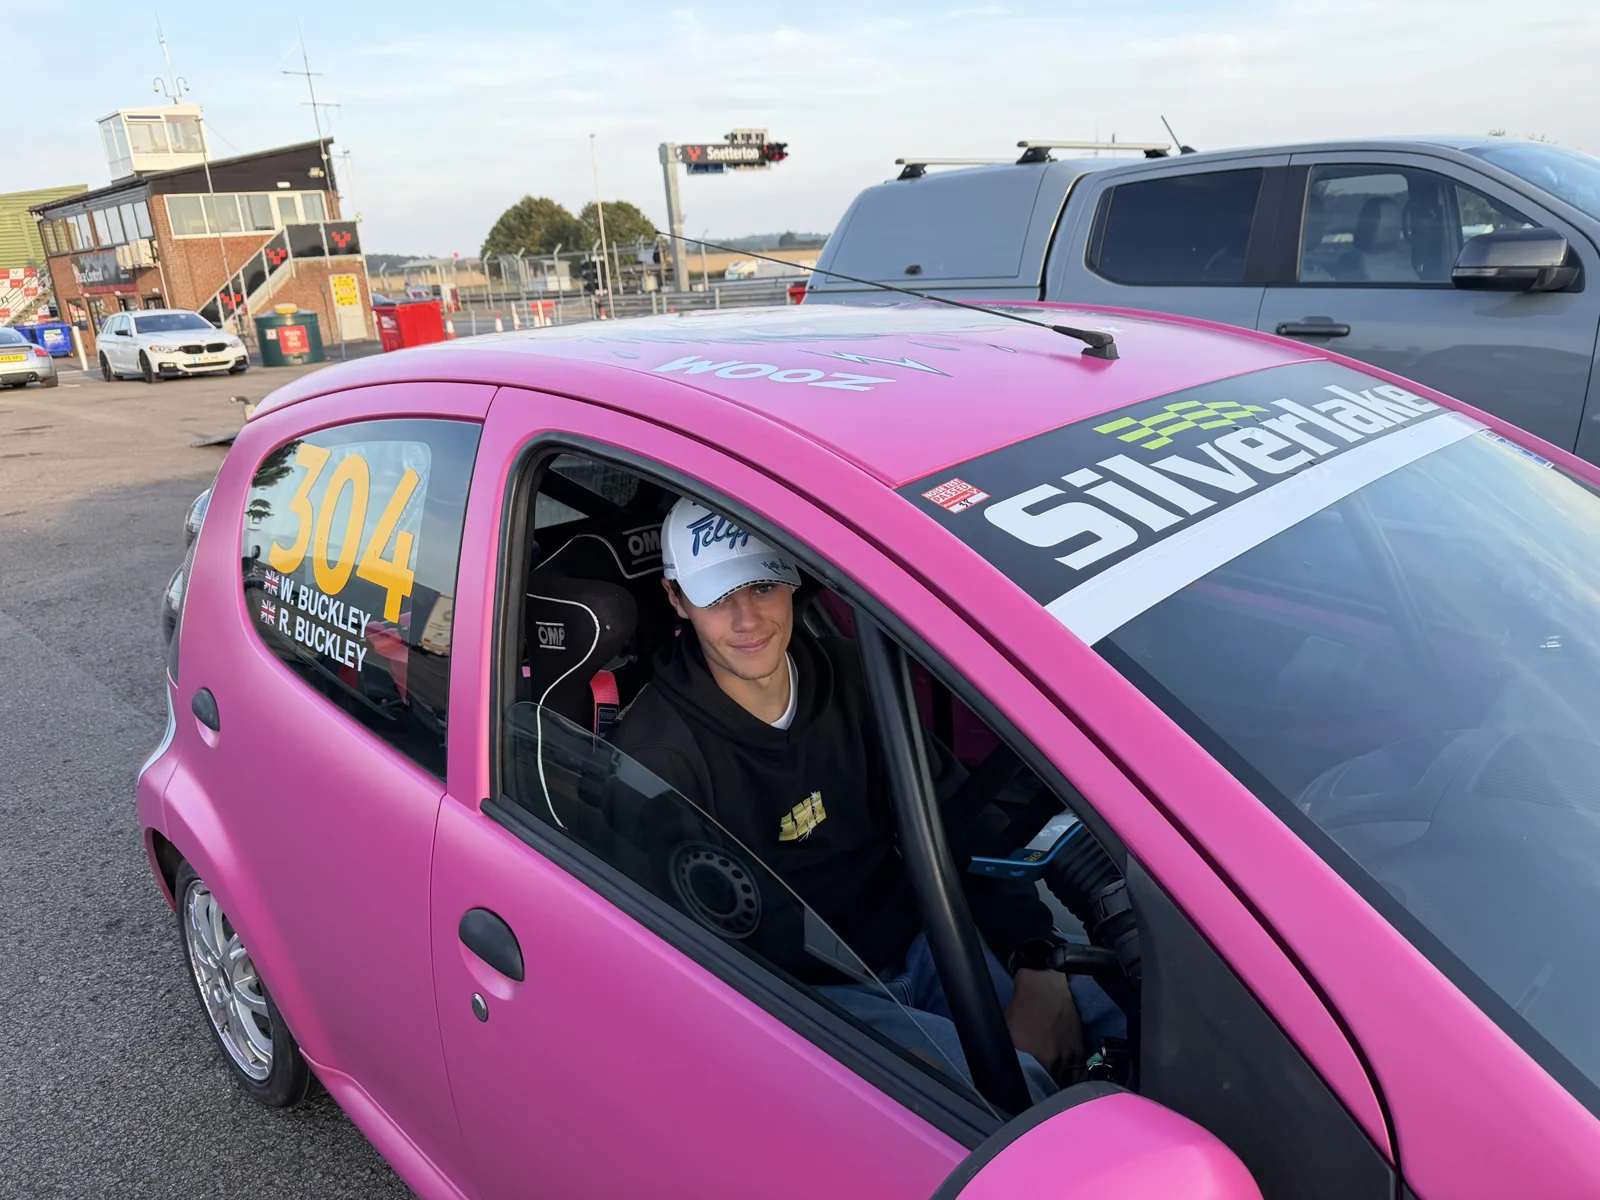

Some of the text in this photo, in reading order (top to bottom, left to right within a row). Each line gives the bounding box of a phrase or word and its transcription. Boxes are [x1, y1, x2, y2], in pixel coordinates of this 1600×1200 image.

[707, 146, 759, 160] Snetterton
[932, 483, 969, 502] PASSED
[983, 385, 1441, 571] Silverlake
[268, 442, 415, 624] 304
[628, 530, 662, 556] OM
[280, 576, 371, 639] W. BUCKLEY
[279, 608, 368, 672] R. BUCKLEY
[537, 625, 565, 646] OMP
